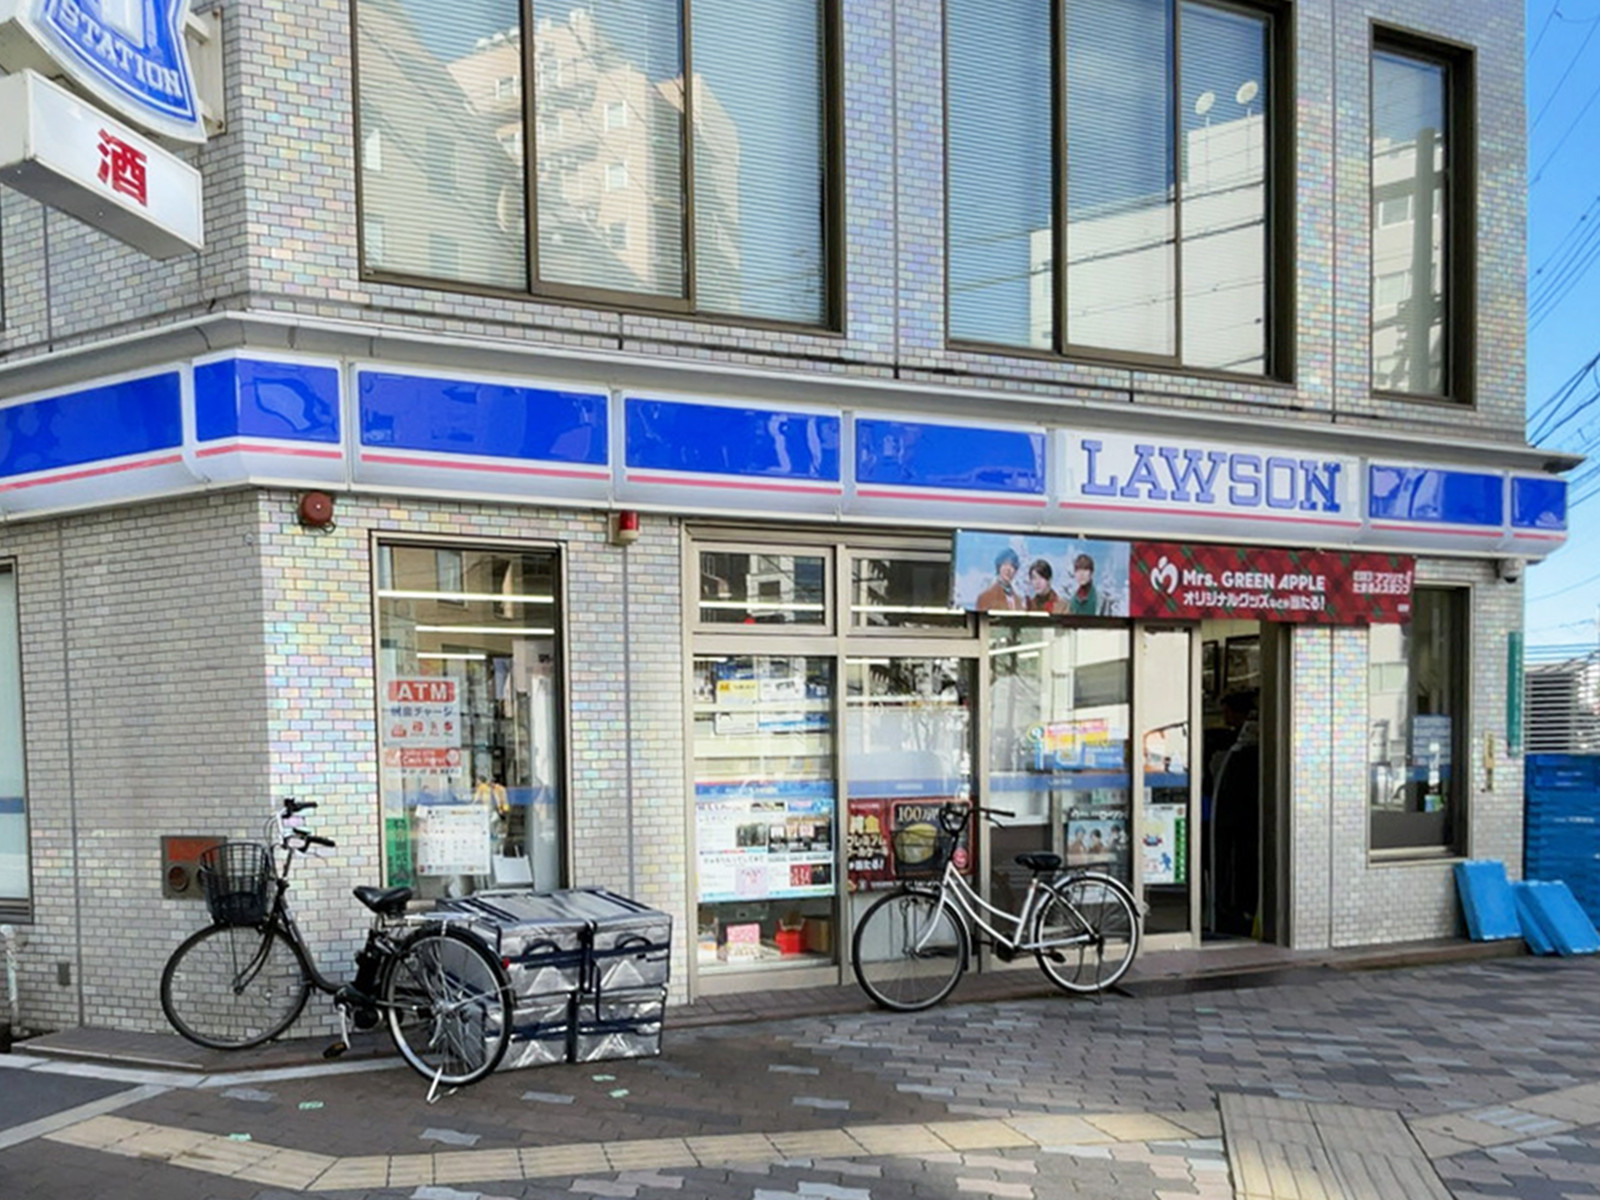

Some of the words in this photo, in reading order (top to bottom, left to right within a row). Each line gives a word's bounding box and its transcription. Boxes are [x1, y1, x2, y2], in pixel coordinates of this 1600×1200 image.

[59, 1, 183, 99] STATION
[97, 128, 147, 207] 酒
[1081, 439, 1341, 512] LAWSON
[1183, 569, 1218, 587] Mrs.
[1221, 571, 1275, 590] GREEN
[1277, 574, 1326, 591] APPLE
[397, 682, 447, 700] ATM
